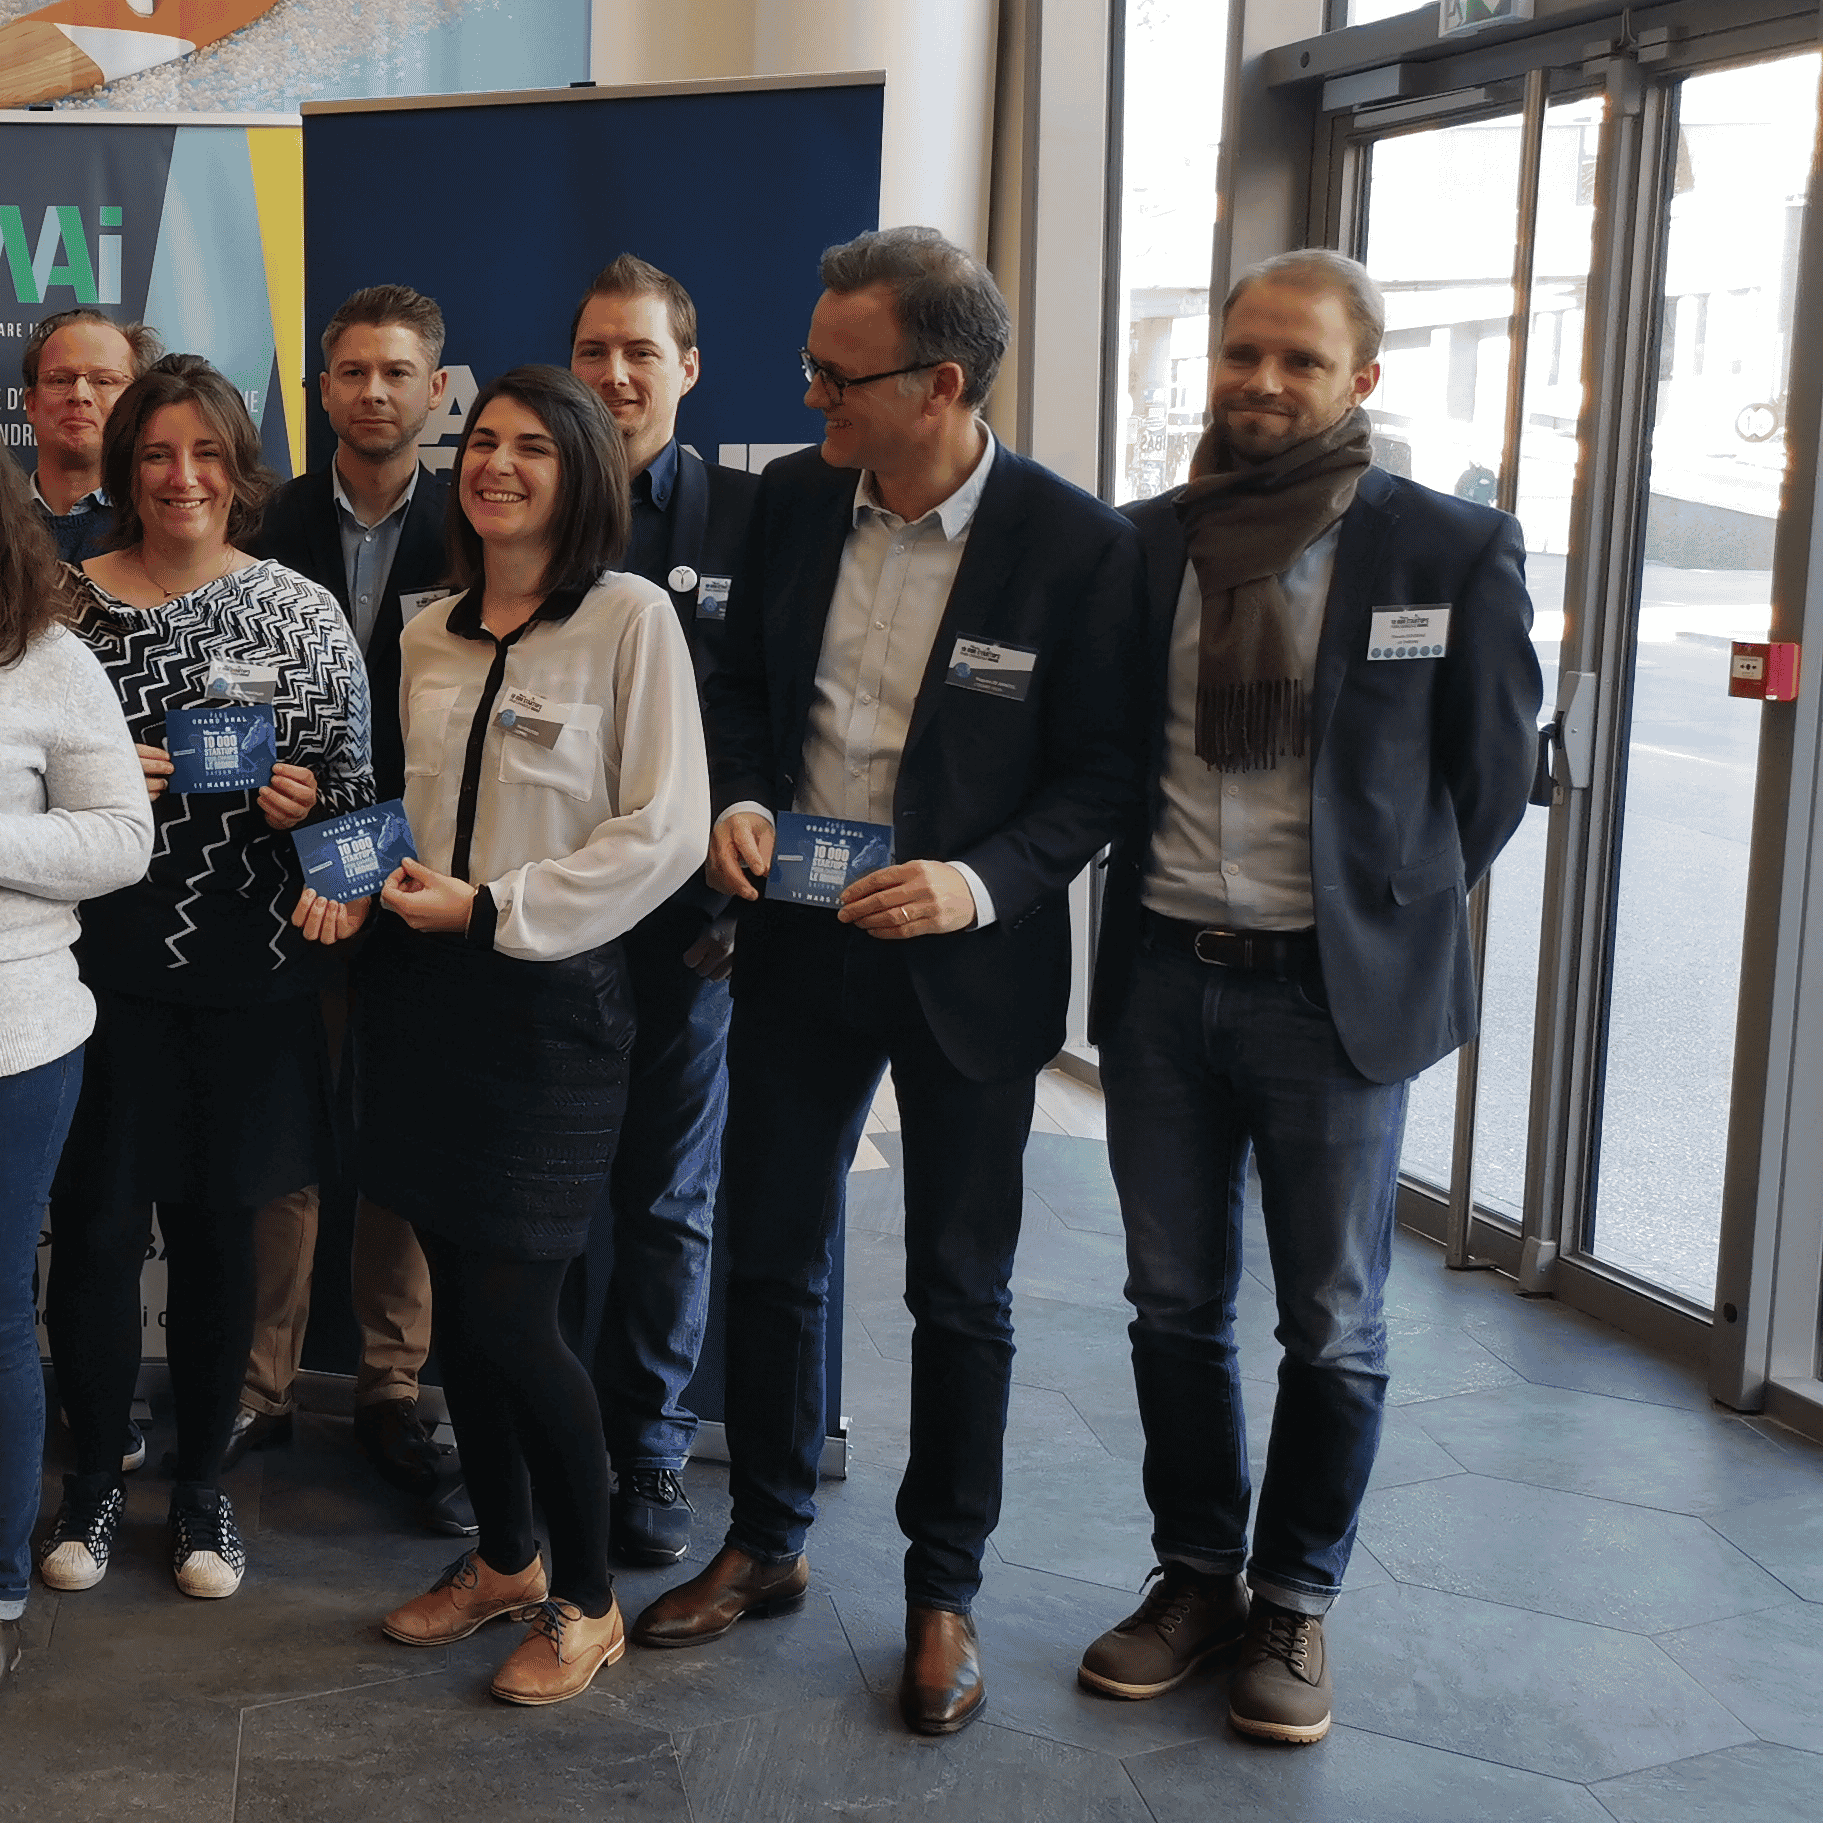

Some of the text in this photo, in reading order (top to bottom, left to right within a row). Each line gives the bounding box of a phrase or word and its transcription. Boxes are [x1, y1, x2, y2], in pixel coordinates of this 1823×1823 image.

[216, 734, 238, 748] 000
[351, 836, 374, 853] 000
[827, 847, 850, 862] 000
